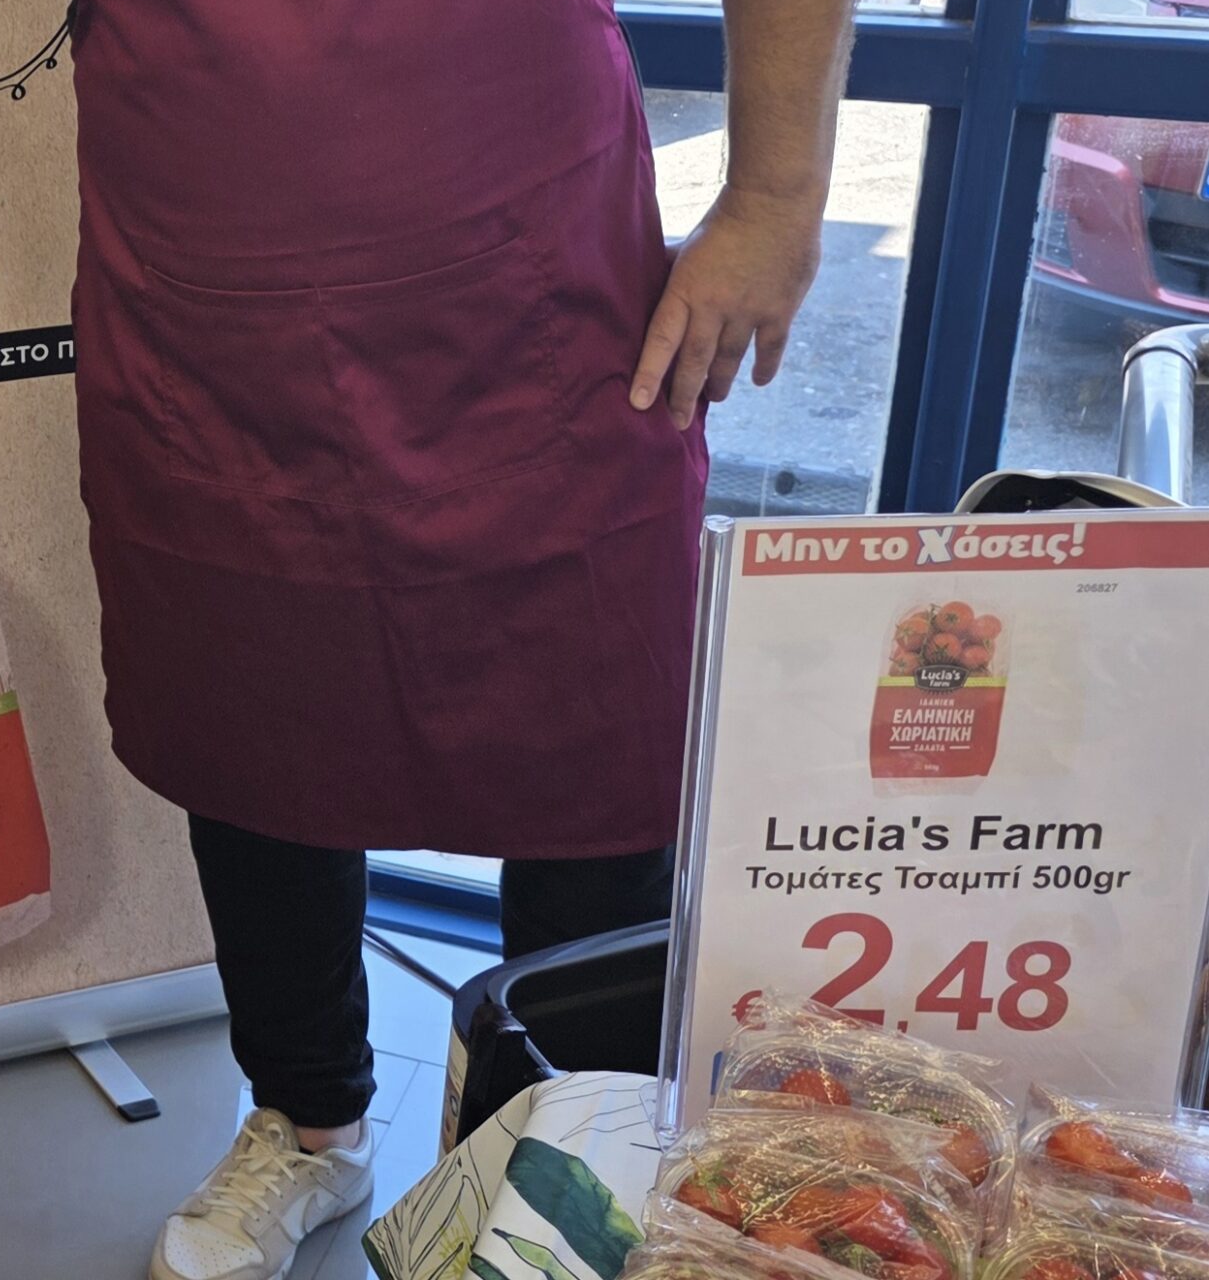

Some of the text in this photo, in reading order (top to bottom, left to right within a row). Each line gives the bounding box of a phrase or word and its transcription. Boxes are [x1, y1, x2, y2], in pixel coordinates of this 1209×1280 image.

[0, 343, 49, 367] ΣΤΟ
[755, 523, 1087, 565] Μην το Χάσεις!
[921, 669, 961, 680] Lucia's
[893, 708, 975, 724] ΕΛΛΗΝΙΚΗ
[890, 726, 972, 741] ΧΩΡΙΑΤΙΚΗ
[765, 816, 1103, 851] Lucia's Farm
[746, 865, 1131, 895] Τομάτες Τσαμπί 500gr
